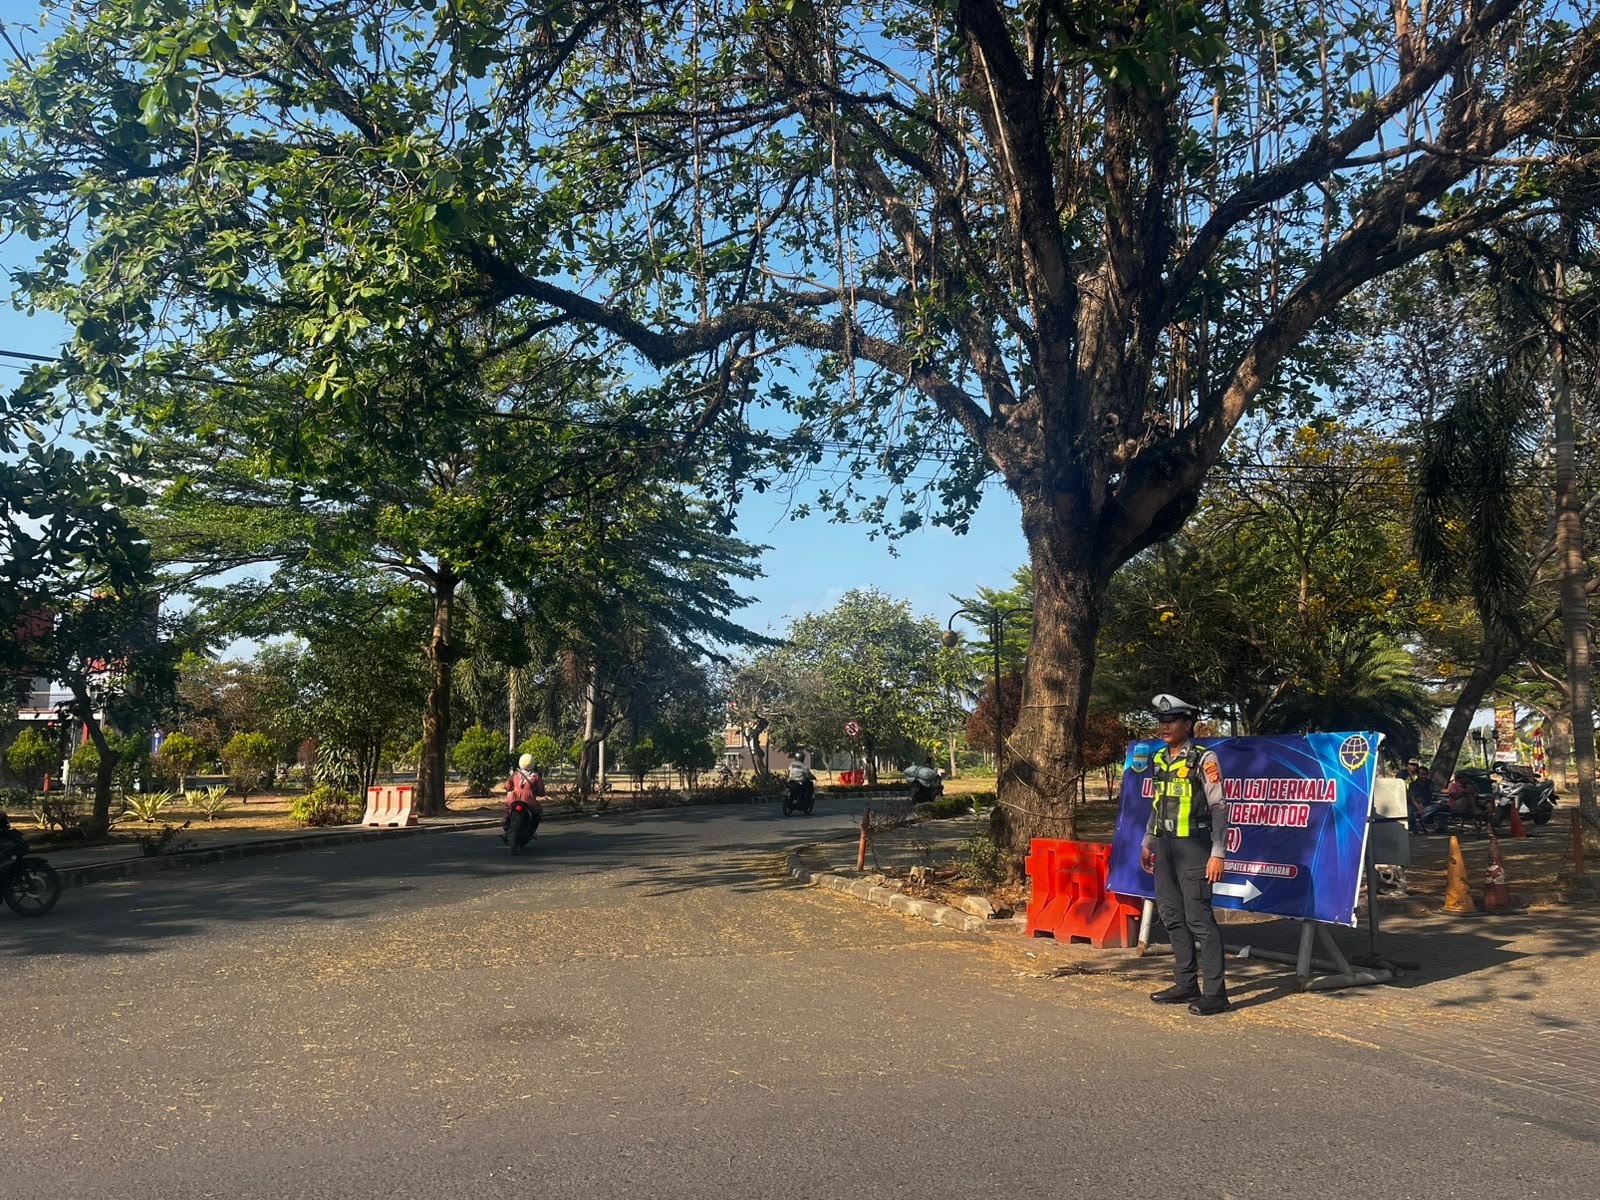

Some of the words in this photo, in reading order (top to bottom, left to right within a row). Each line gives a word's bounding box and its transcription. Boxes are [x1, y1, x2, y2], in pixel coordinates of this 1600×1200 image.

[1243, 779, 1268, 801] UJI
[1268, 779, 1337, 802] BERKALA
[1231, 803, 1310, 827] BERMOTOR
[1227, 827, 1242, 853] R)
